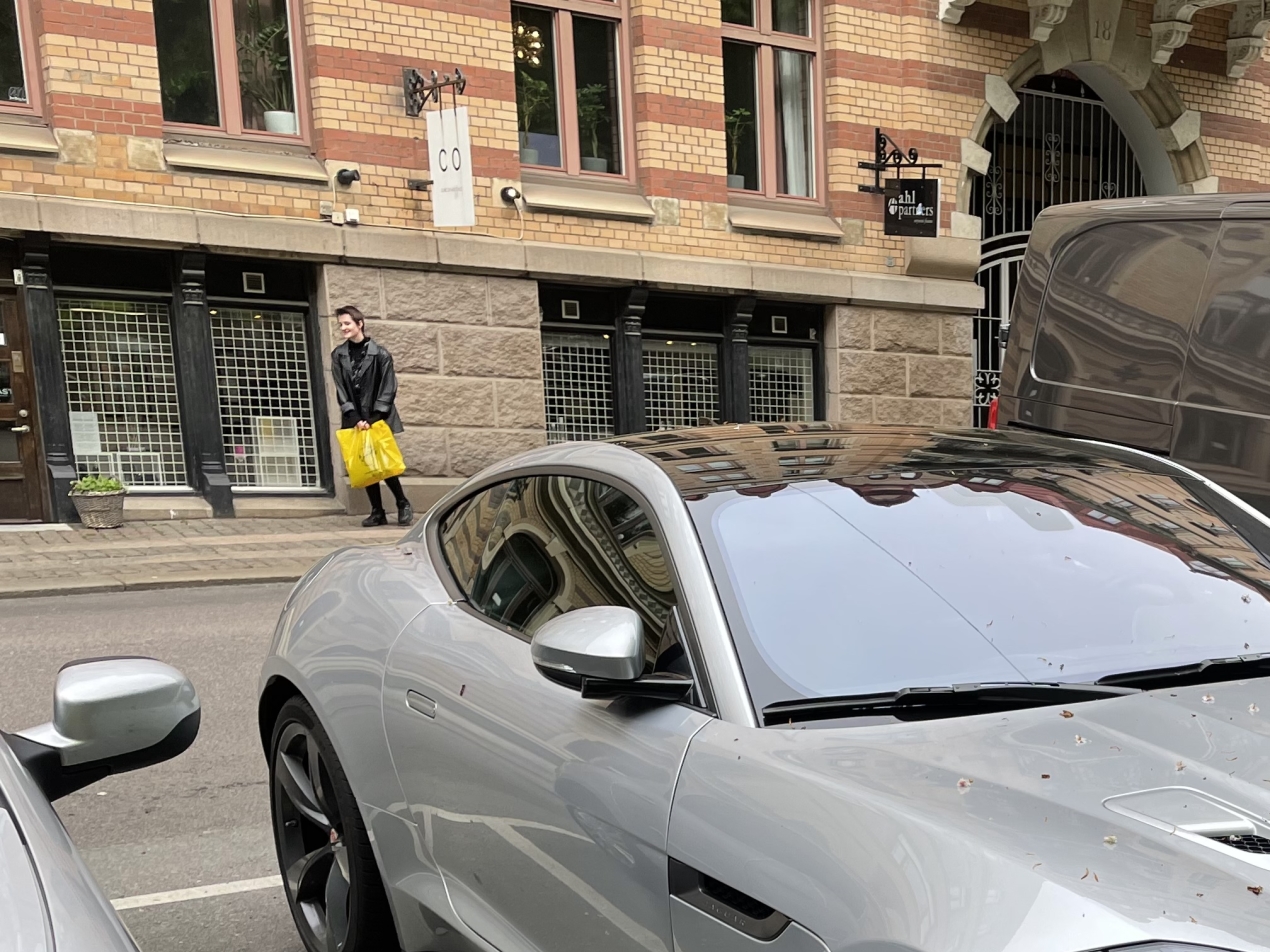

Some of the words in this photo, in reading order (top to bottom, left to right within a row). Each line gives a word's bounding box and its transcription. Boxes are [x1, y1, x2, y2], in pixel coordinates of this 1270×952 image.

[1094, 19, 1111, 41] 18
[438, 147, 462, 172] CO
[898, 190, 916, 204] ahl
